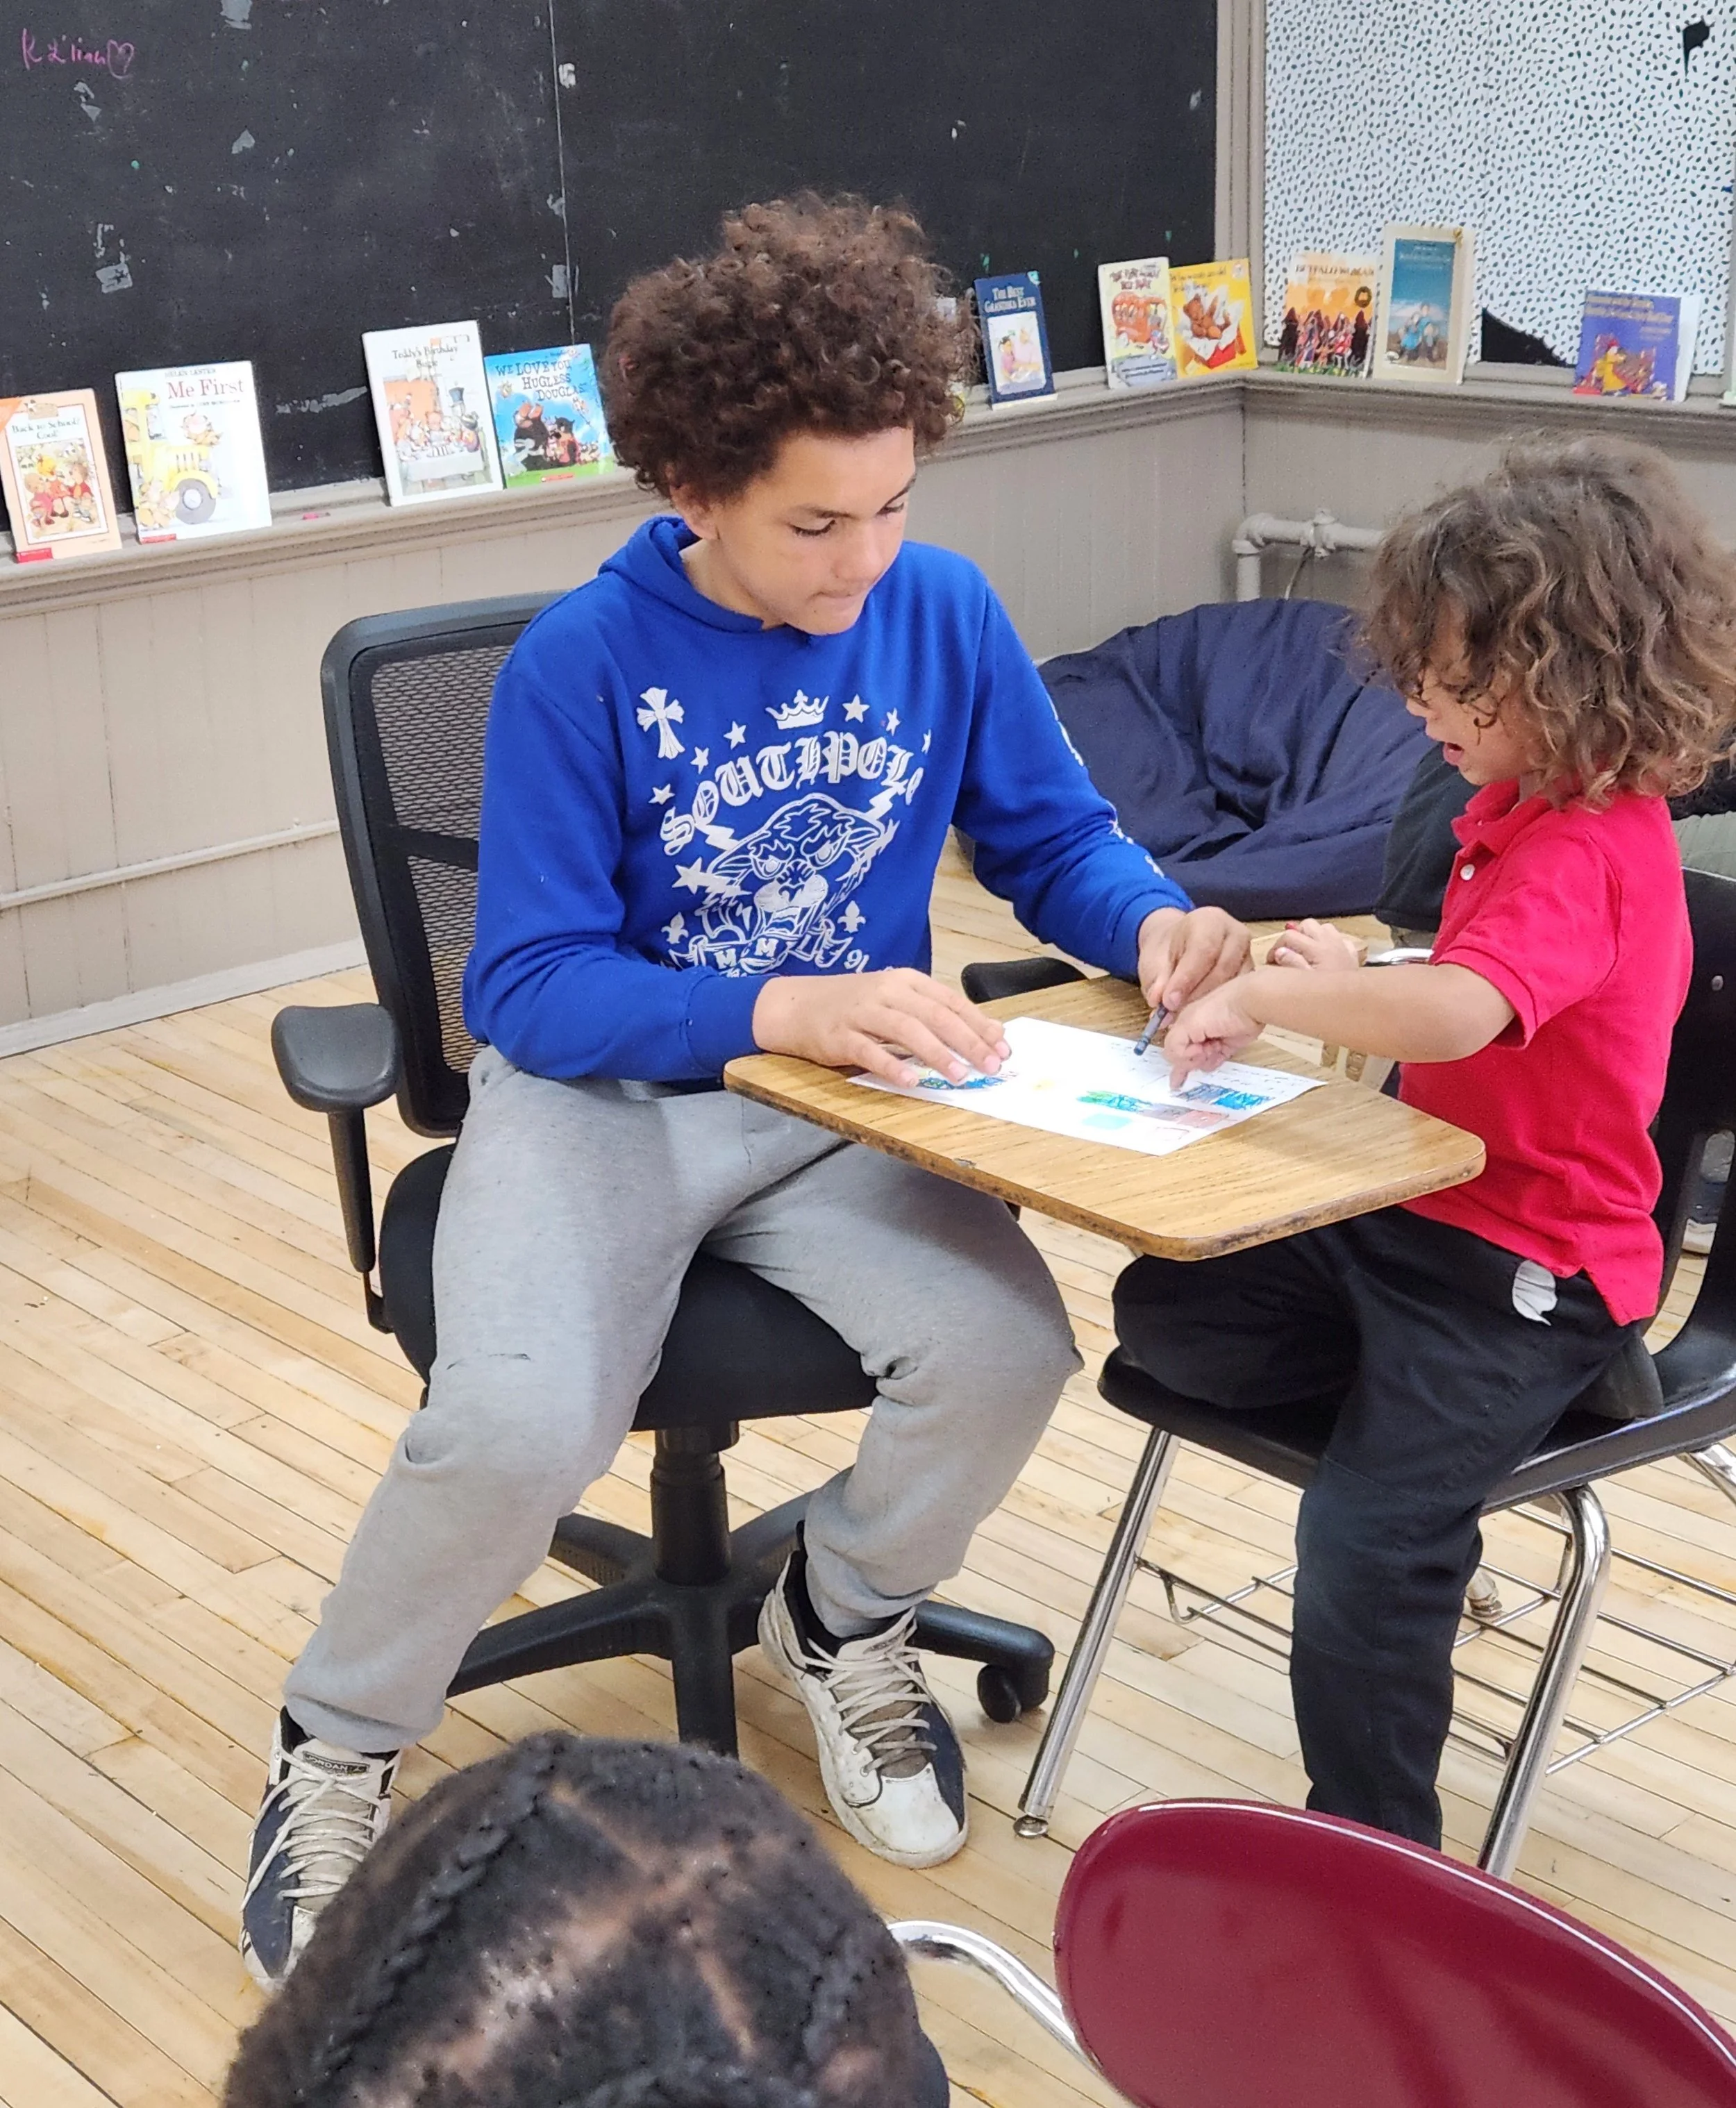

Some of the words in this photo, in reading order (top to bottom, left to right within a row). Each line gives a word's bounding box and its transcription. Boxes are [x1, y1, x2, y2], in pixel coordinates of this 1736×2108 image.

[992, 287, 1006, 301] THE
[1007, 285, 1024, 299] BEST
[1017, 296, 1036, 309] EVER
[495, 365, 513, 377] WE
[516, 360, 549, 376] LOVE
[553, 359, 572, 371] YOU
[167, 380, 194, 399] Me
[199, 378, 244, 396] First
[522, 374, 571, 390] HUGLESS
[536, 383, 587, 401] DOUGLAS
[755, 937, 778, 957] M
[714, 950, 736, 969] M
[306, 1756, 348, 1771] JORDAN
